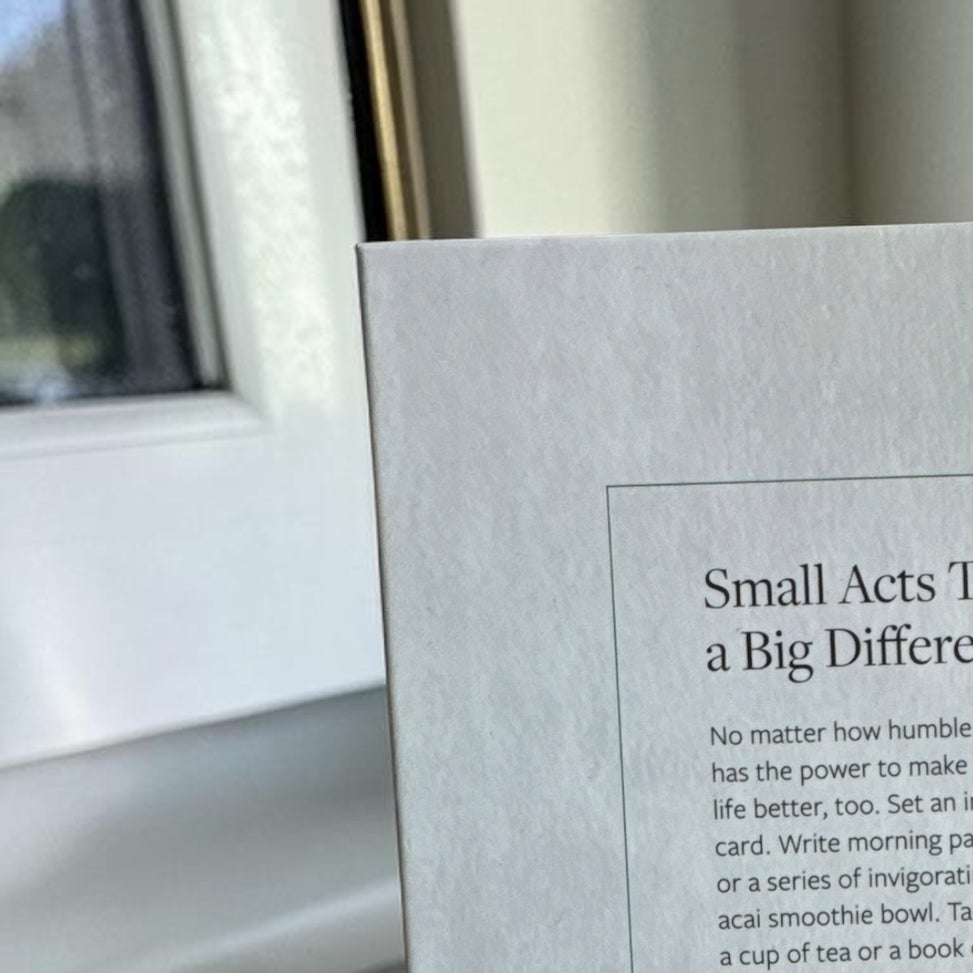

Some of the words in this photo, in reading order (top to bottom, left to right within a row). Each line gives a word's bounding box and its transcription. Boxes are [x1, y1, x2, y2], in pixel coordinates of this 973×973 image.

[704, 563, 828, 609] Small
[838, 564, 936, 604] Acts
[706, 643, 731, 672] a
[740, 630, 814, 684] Big
[710, 726, 743, 746] No
[751, 725, 827, 745] matter
[833, 720, 881, 742] how
[888, 716, 972, 740] humble
[712, 762, 749, 783] has
[755, 760, 792, 782] the
[800, 762, 871, 787] power
[877, 760, 902, 778] to
[909, 754, 967, 776] make
[713, 798, 746, 820] life
[753, 797, 828, 820] better,
[834, 798, 880, 816] too.
[888, 794, 924, 814] Set
[930, 796, 956, 813] an
[715, 834, 770, 857] card.
[778, 833, 840, 854] Write
[848, 829, 942, 856] morning
[717, 877, 742, 893] or
[748, 877, 761, 892] a
[767, 870, 831, 892] series
[838, 867, 862, 889] of
[718, 908, 760, 930] acai
[768, 904, 873, 928] smoothie
[881, 901, 940, 924] bowl.
[720, 951, 732, 966] a
[739, 946, 780, 971] cup
[787, 941, 810, 964] of
[816, 945, 851, 963] tea
[858, 945, 883, 961] or
[889, 945, 902, 960] a
[908, 937, 964, 960] book
